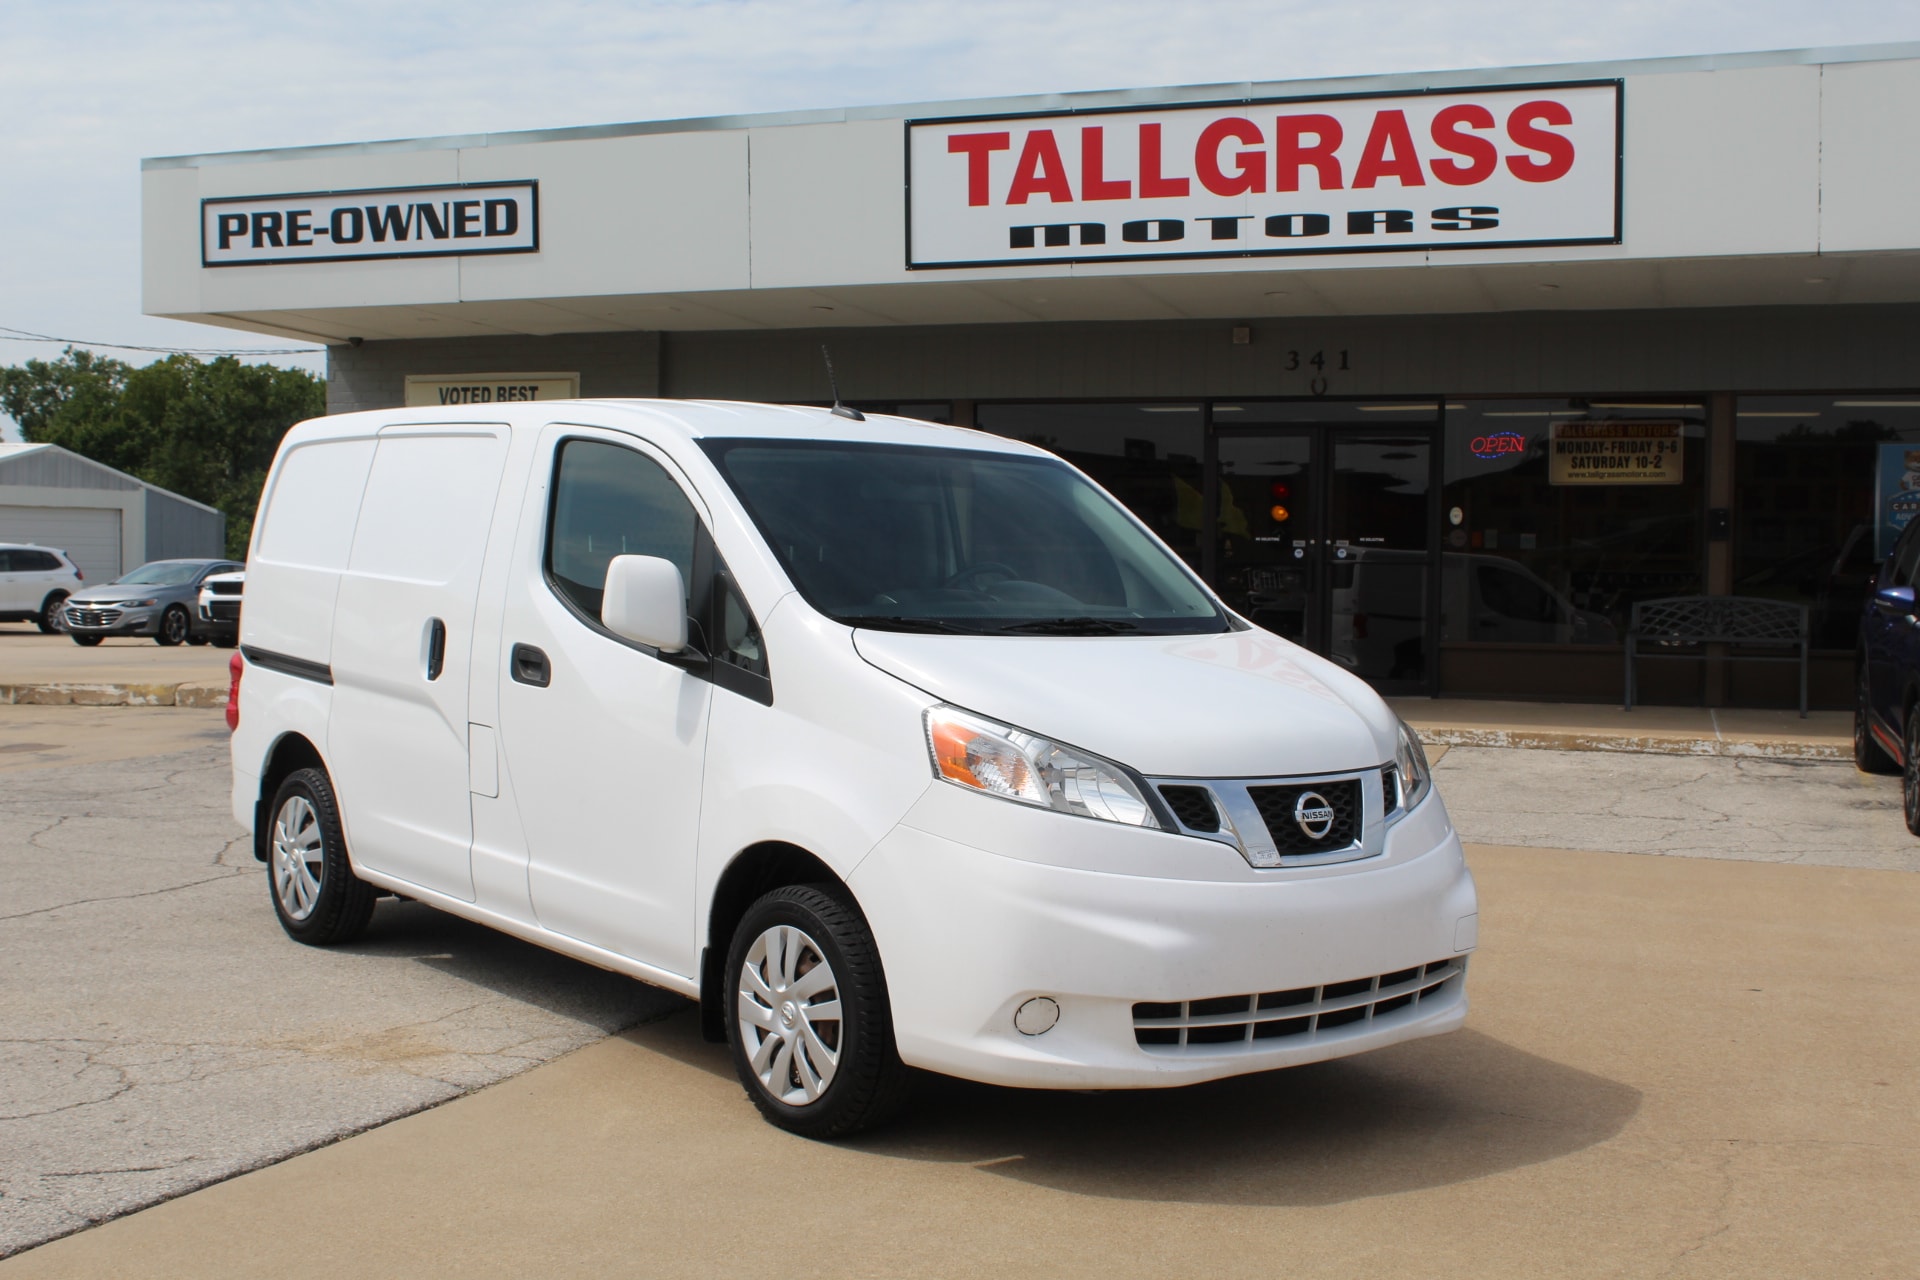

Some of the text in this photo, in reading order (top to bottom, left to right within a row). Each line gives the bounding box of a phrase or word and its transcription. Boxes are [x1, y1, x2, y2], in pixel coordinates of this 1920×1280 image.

[948, 101, 1575, 207] TALLGRASS
[218, 198, 518, 250] PRE-OWNED
[438, 386, 539, 405] VOTED BEST
[1557, 425, 1678, 437] TALLGRASS MOTORS
[1470, 436, 1526, 453] OPEN
[1556, 440, 1678, 454] MONDAY-FRIDAY 9-6
[1571, 455, 1662, 469] SATURDAY 10-2
[1302, 810, 1333, 820] NISSAN
